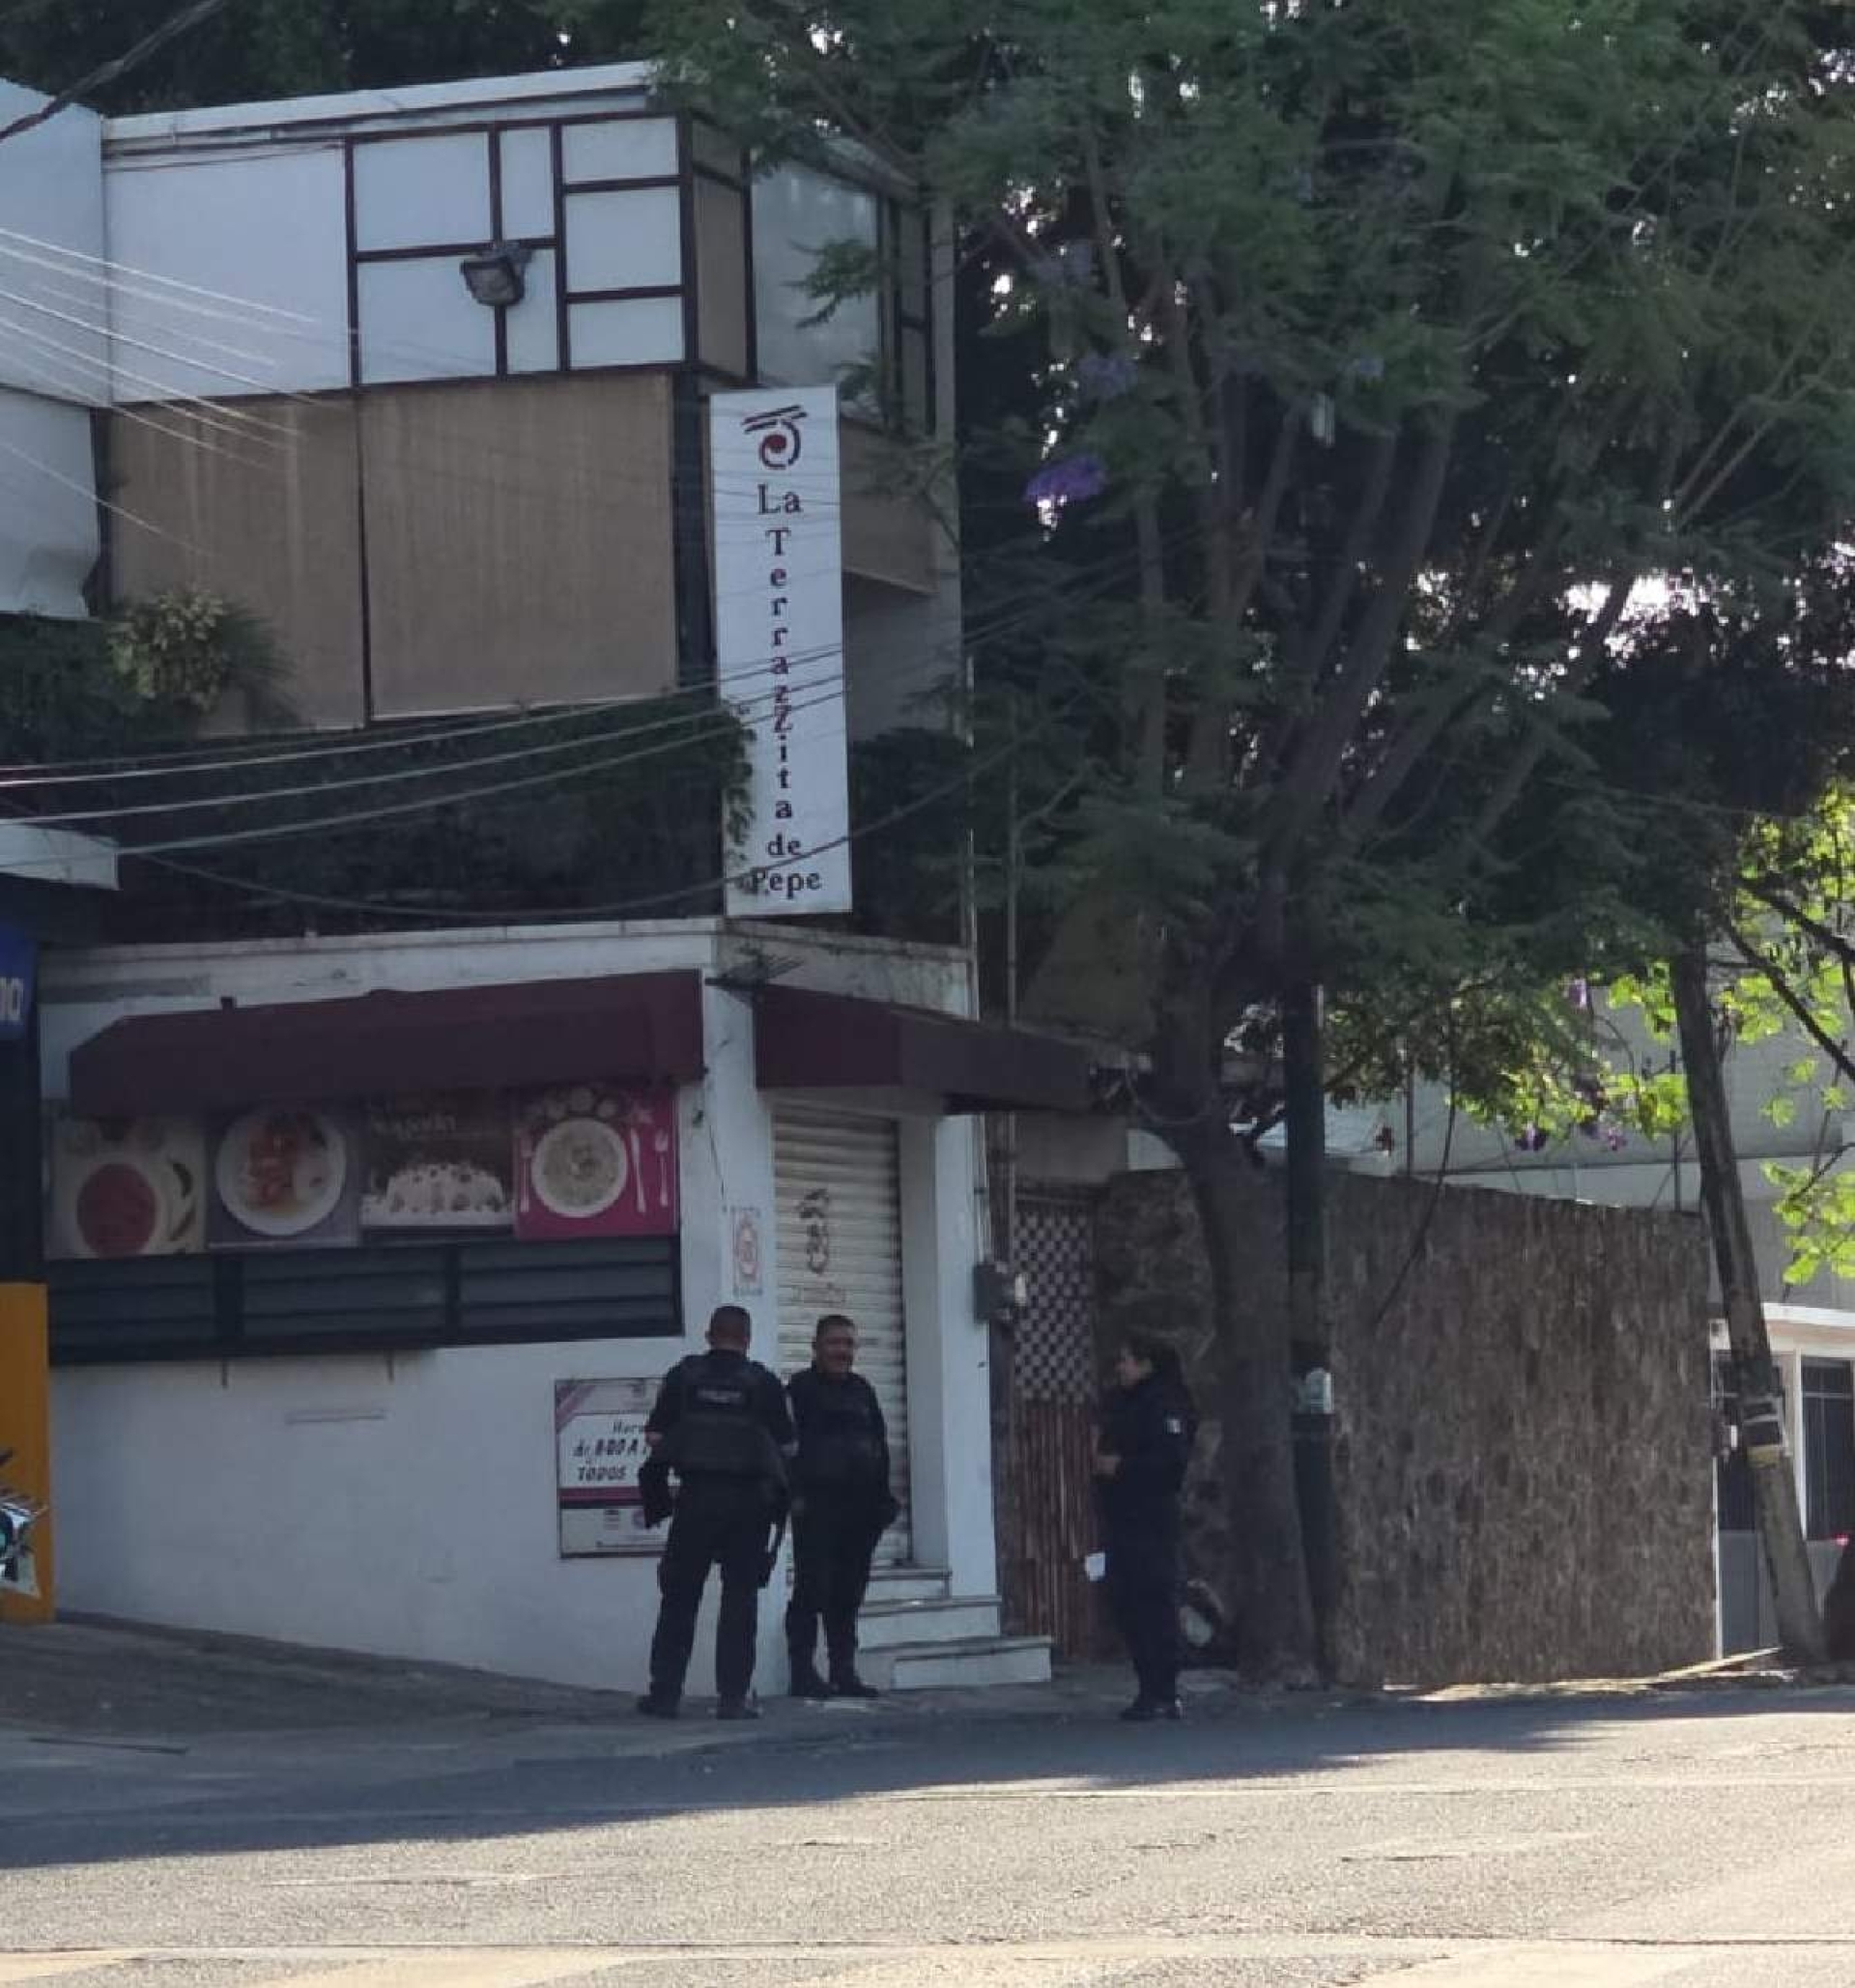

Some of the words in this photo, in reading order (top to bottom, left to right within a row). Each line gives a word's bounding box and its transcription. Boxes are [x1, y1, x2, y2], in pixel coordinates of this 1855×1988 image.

[757, 484, 803, 515] La
[767, 834, 802, 857] de
[751, 867, 822, 899] Pepe
